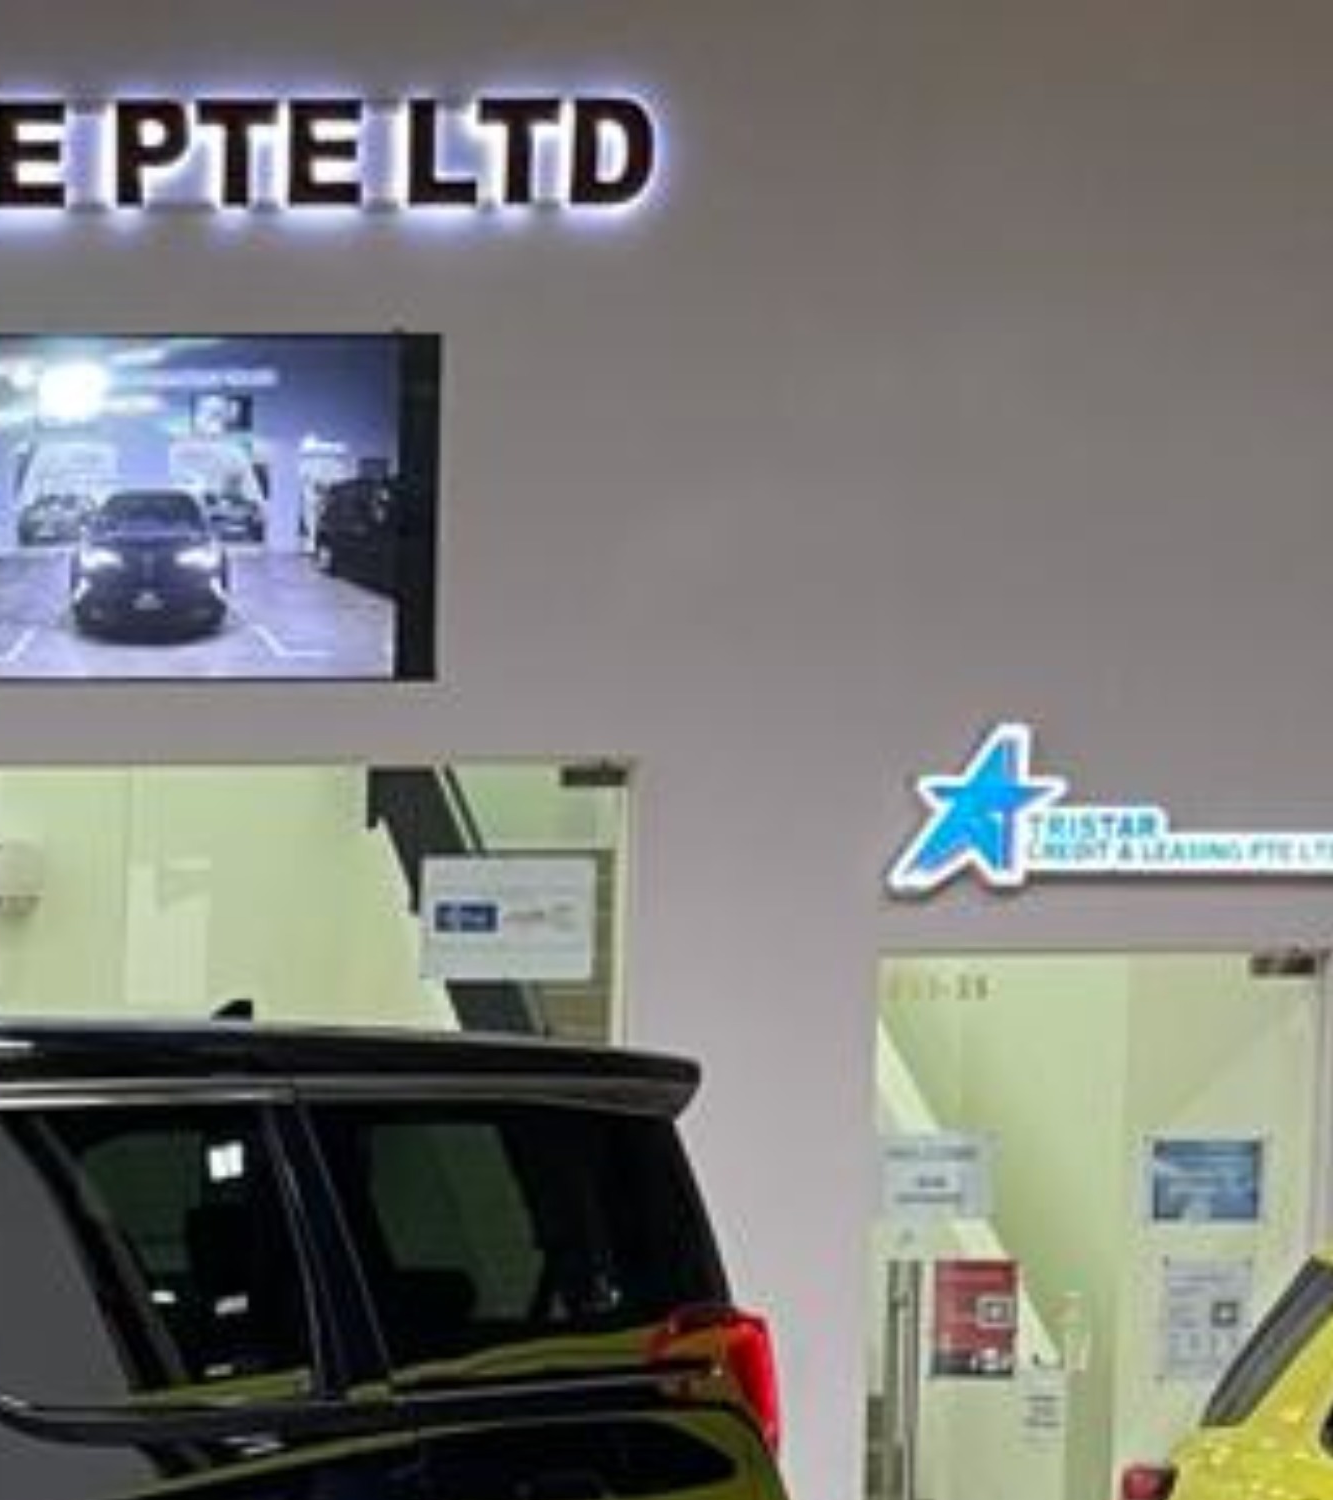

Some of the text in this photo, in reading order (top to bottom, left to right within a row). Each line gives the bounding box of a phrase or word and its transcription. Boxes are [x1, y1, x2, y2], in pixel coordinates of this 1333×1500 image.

[115, 98, 363, 206] PTE
[407, 98, 655, 206] LTD
[1030, 813, 1156, 837] TRISTAR
